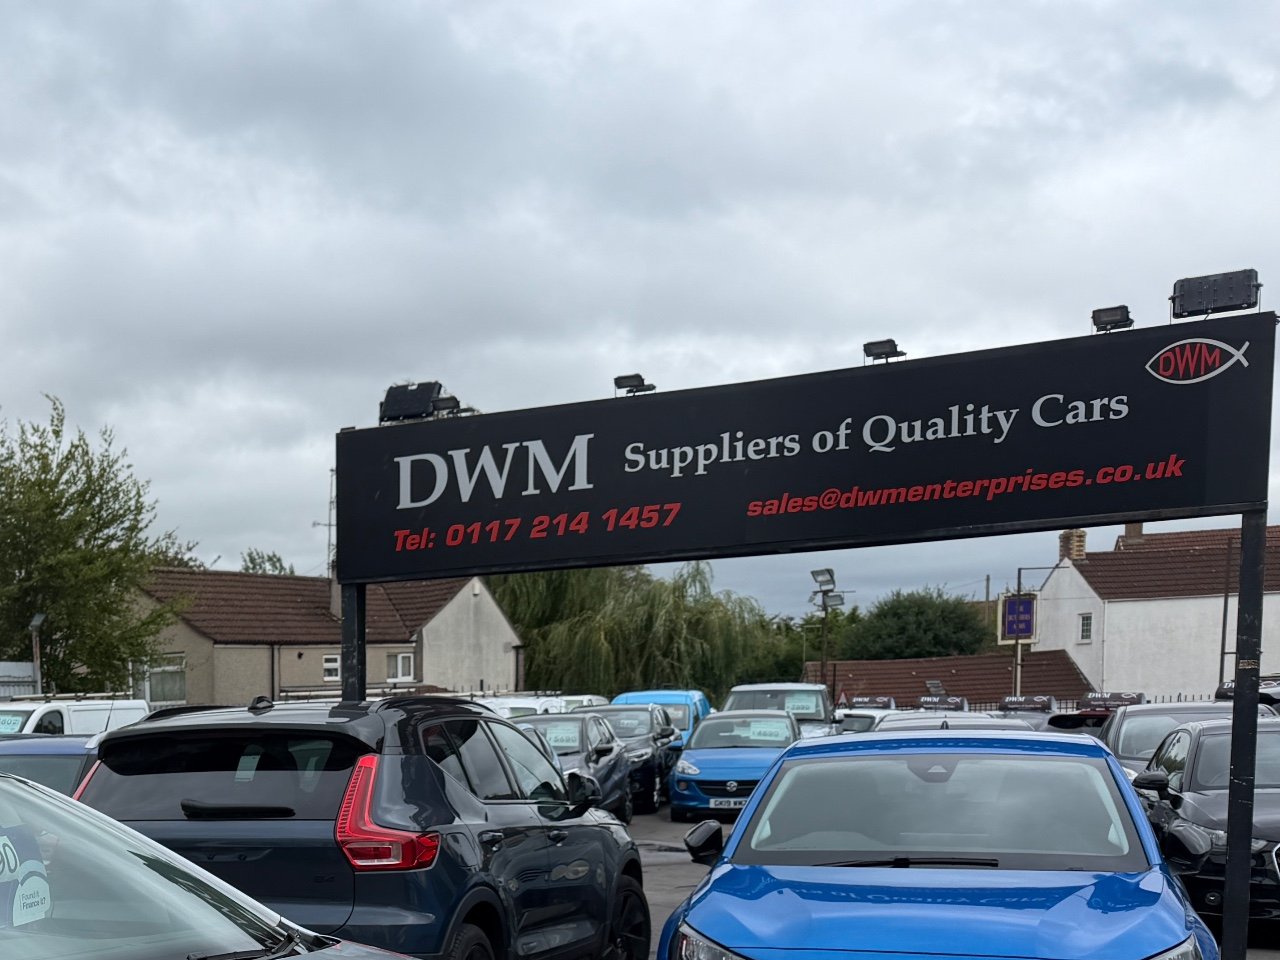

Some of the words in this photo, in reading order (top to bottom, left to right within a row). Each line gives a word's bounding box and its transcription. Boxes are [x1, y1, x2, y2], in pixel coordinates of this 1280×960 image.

[1158, 343, 1221, 379] DWM
[624, 431, 800, 478] Suppliers
[812, 417, 852, 453] of
[862, 404, 1019, 453] Quality
[1031, 393, 1130, 428] Cars
[394, 433, 594, 510] DWM
[747, 454, 1185, 517] sales@dwmenterprises.co.uk
[394, 526, 436, 551] Tel:
[445, 518, 522, 546] 0117
[530, 511, 590, 539] 214
[601, 502, 682, 532] 1457
